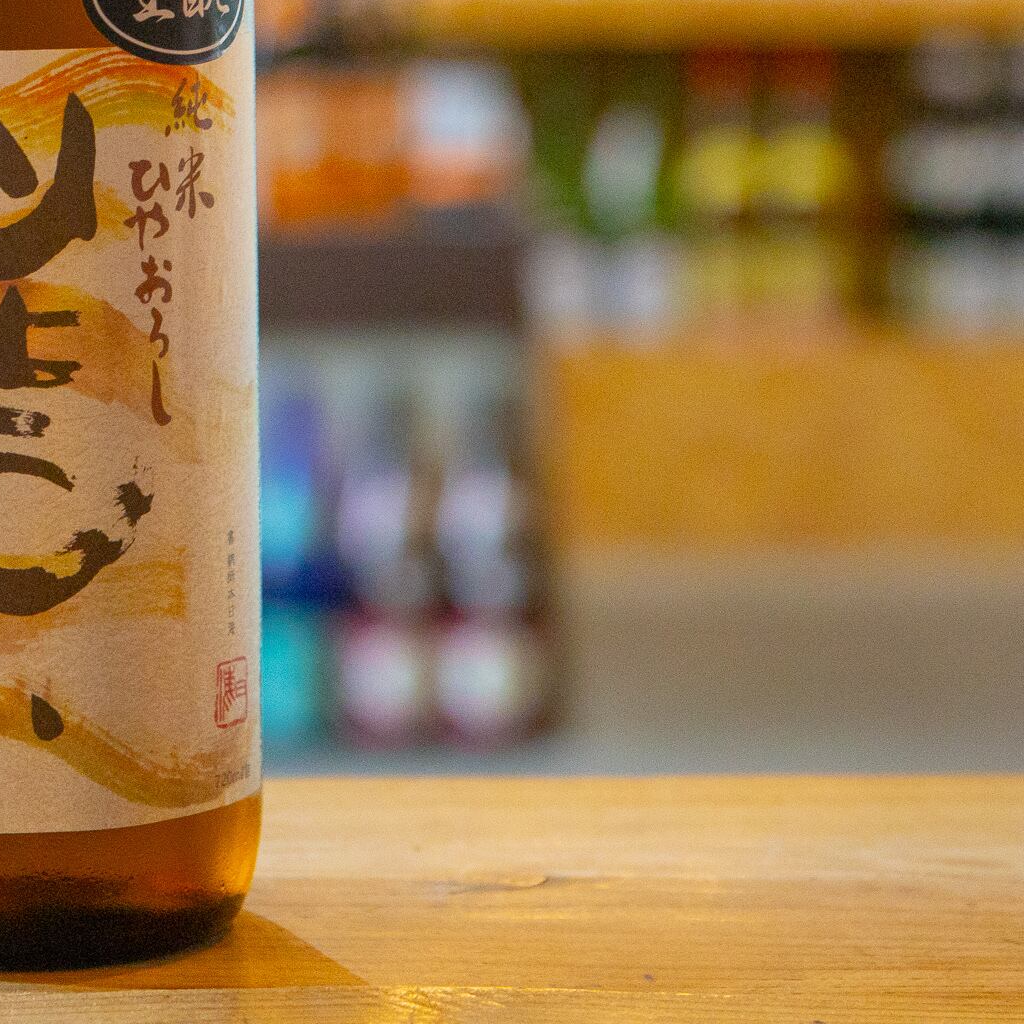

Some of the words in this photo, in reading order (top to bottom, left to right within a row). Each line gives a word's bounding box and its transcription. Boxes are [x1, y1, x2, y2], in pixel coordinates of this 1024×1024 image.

[165, 77, 215, 219] 純米
[123, 159, 174, 427] ひやおろし
